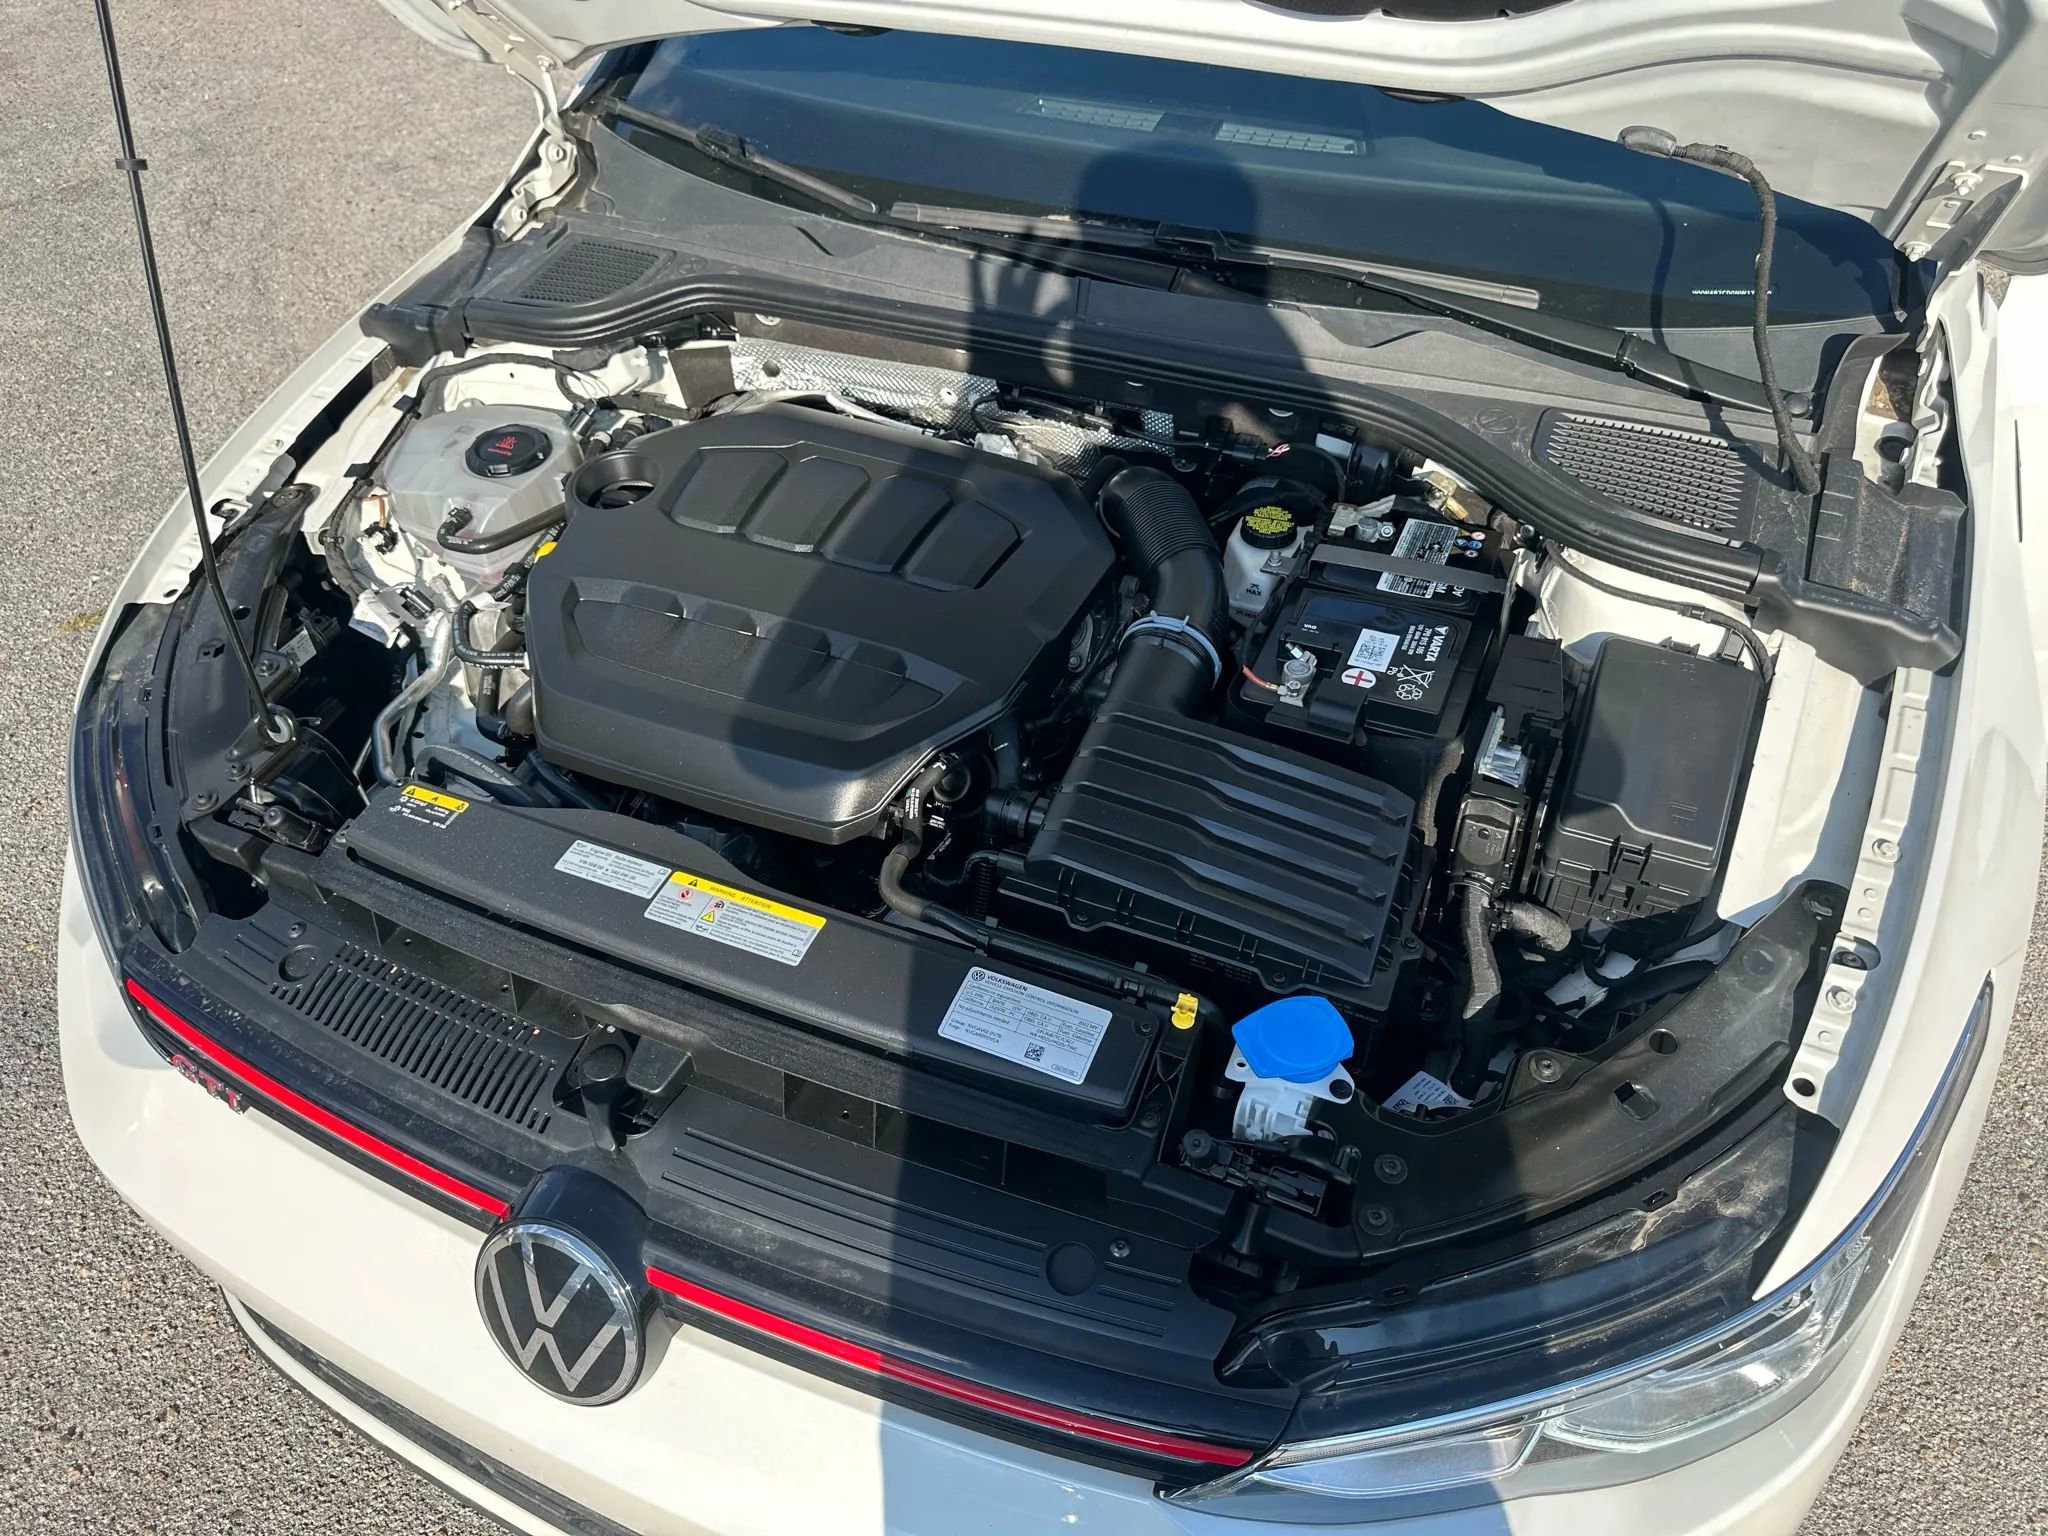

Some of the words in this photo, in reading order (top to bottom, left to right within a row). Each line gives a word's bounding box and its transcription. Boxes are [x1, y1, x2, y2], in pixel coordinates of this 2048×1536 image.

[1246, 588, 1262, 597] MAX
[1424, 636, 1446, 662] VARTA
[1387, 666, 1398, 675] Pb
[710, 886, 736, 898] WARNING
[741, 896, 772, 909] ATTENTION
[986, 974, 1028, 991] VOLKSWAGEN
[984, 980, 1002, 988] VEHICLE
[1003, 986, 1024, 995] EMISSION
[1025, 993, 1045, 1002] CONTROL
[1046, 1000, 1079, 1014] INFORMATION
[965, 1006, 992, 1019] adjustments
[993, 1016, 1010, 1024] needed
[1072, 1033, 1092, 1043] Gasoline
[1075, 1027, 1094, 1036] Gasoline
[171, 1054, 242, 1115] GTI
[482, 1227, 633, 1397] VW
